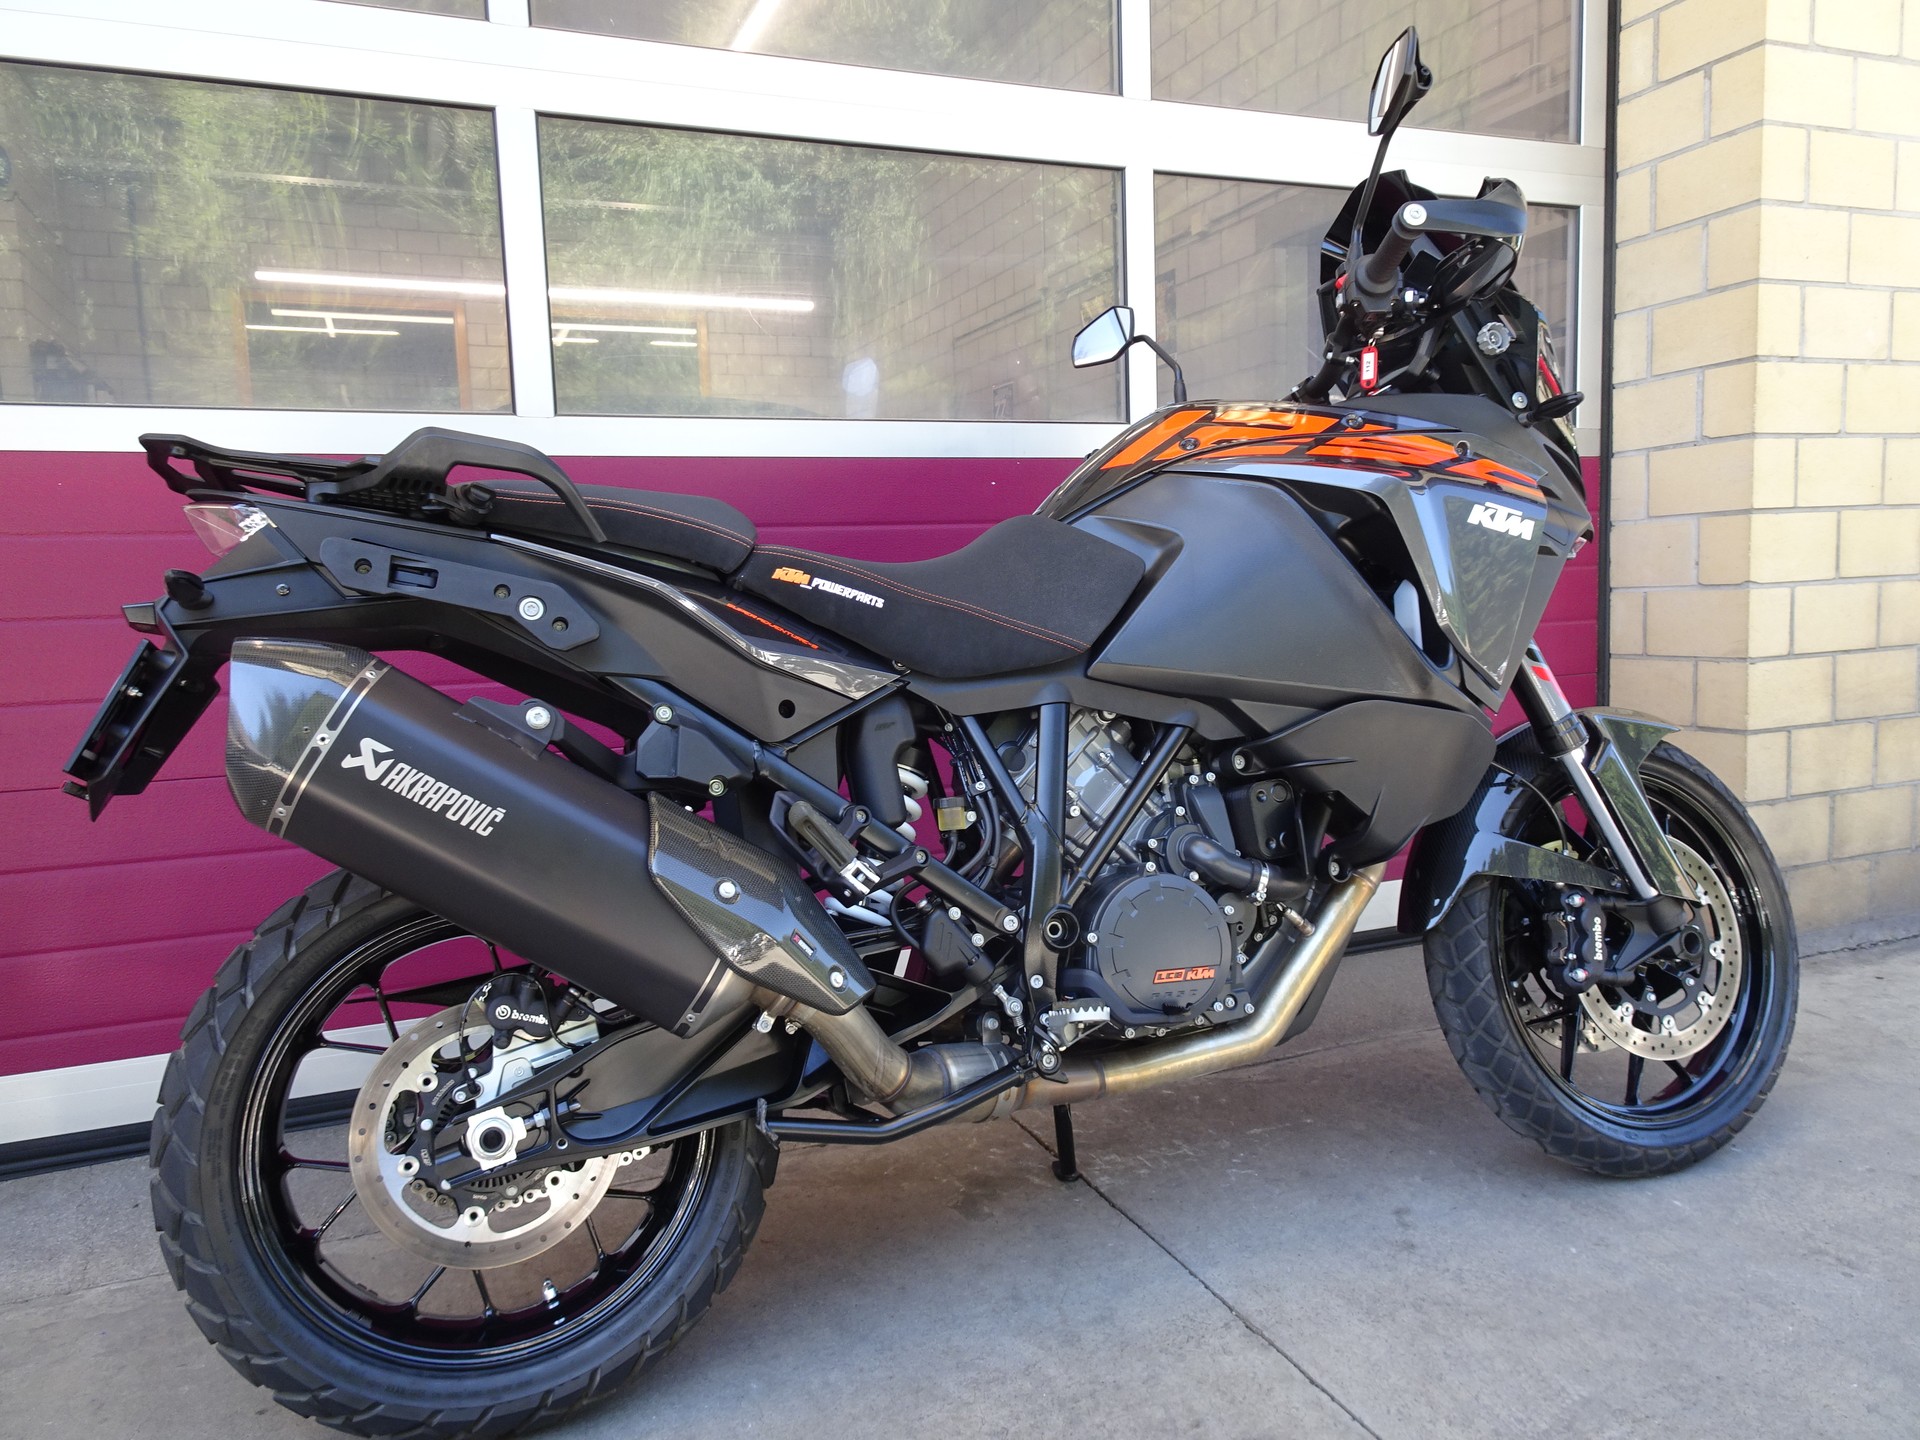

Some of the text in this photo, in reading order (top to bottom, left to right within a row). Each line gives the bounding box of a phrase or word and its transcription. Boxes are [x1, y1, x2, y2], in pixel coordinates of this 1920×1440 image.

[1467, 501, 1535, 541] KTM
[771, 566, 885, 609] KTM POWERPARTS
[1592, 916, 1603, 961] brembo
[1185, 966, 1216, 981] KTM
